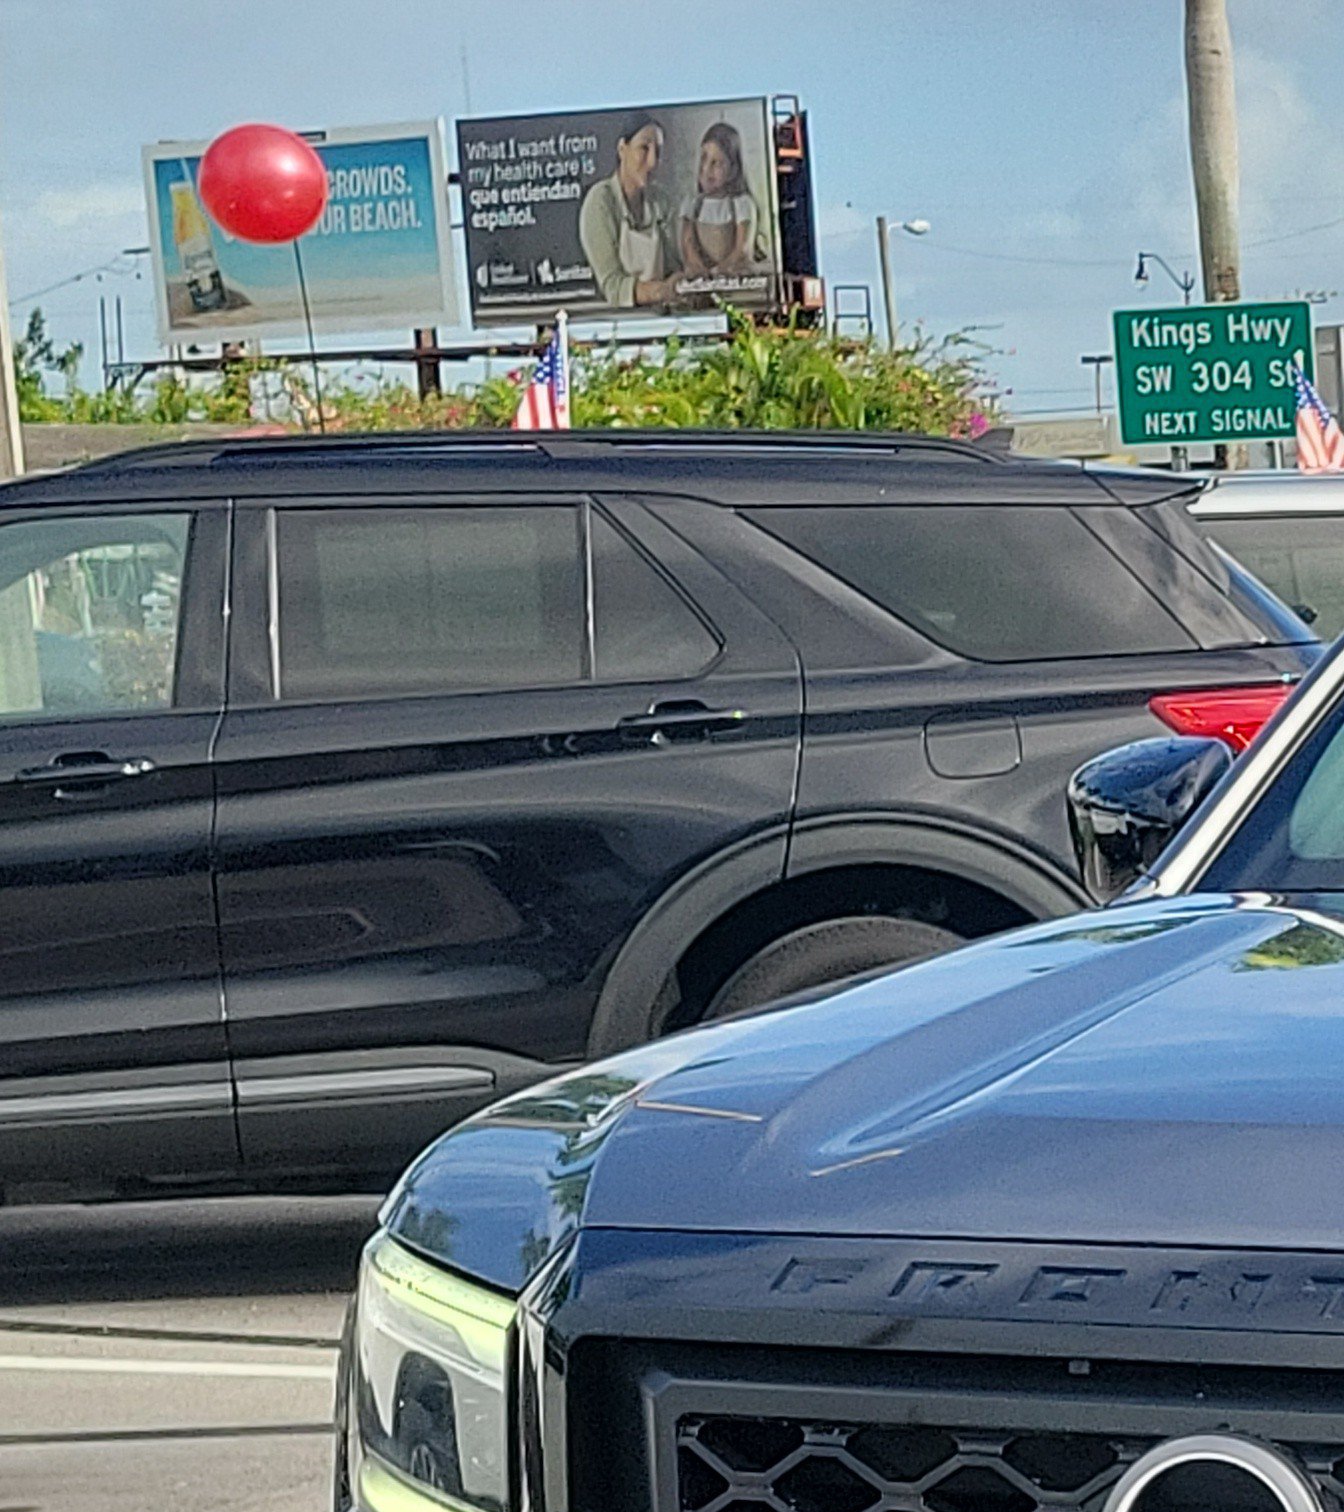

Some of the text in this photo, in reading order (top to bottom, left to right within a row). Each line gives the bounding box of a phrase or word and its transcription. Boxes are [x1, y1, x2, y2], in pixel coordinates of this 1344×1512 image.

[466, 139, 506, 161] What
[517, 137, 556, 157] want
[558, 133, 598, 154] from
[468, 155, 596, 187] my health care is
[470, 180, 581, 209] que entiendan
[349, 197, 422, 232] BEACH.
[471, 205, 537, 232] español.
[1131, 312, 1292, 355] Kings Hwy
[1136, 358, 1296, 394] SW 304 St
[1144, 406, 1291, 435] NEXT SIGNAL
